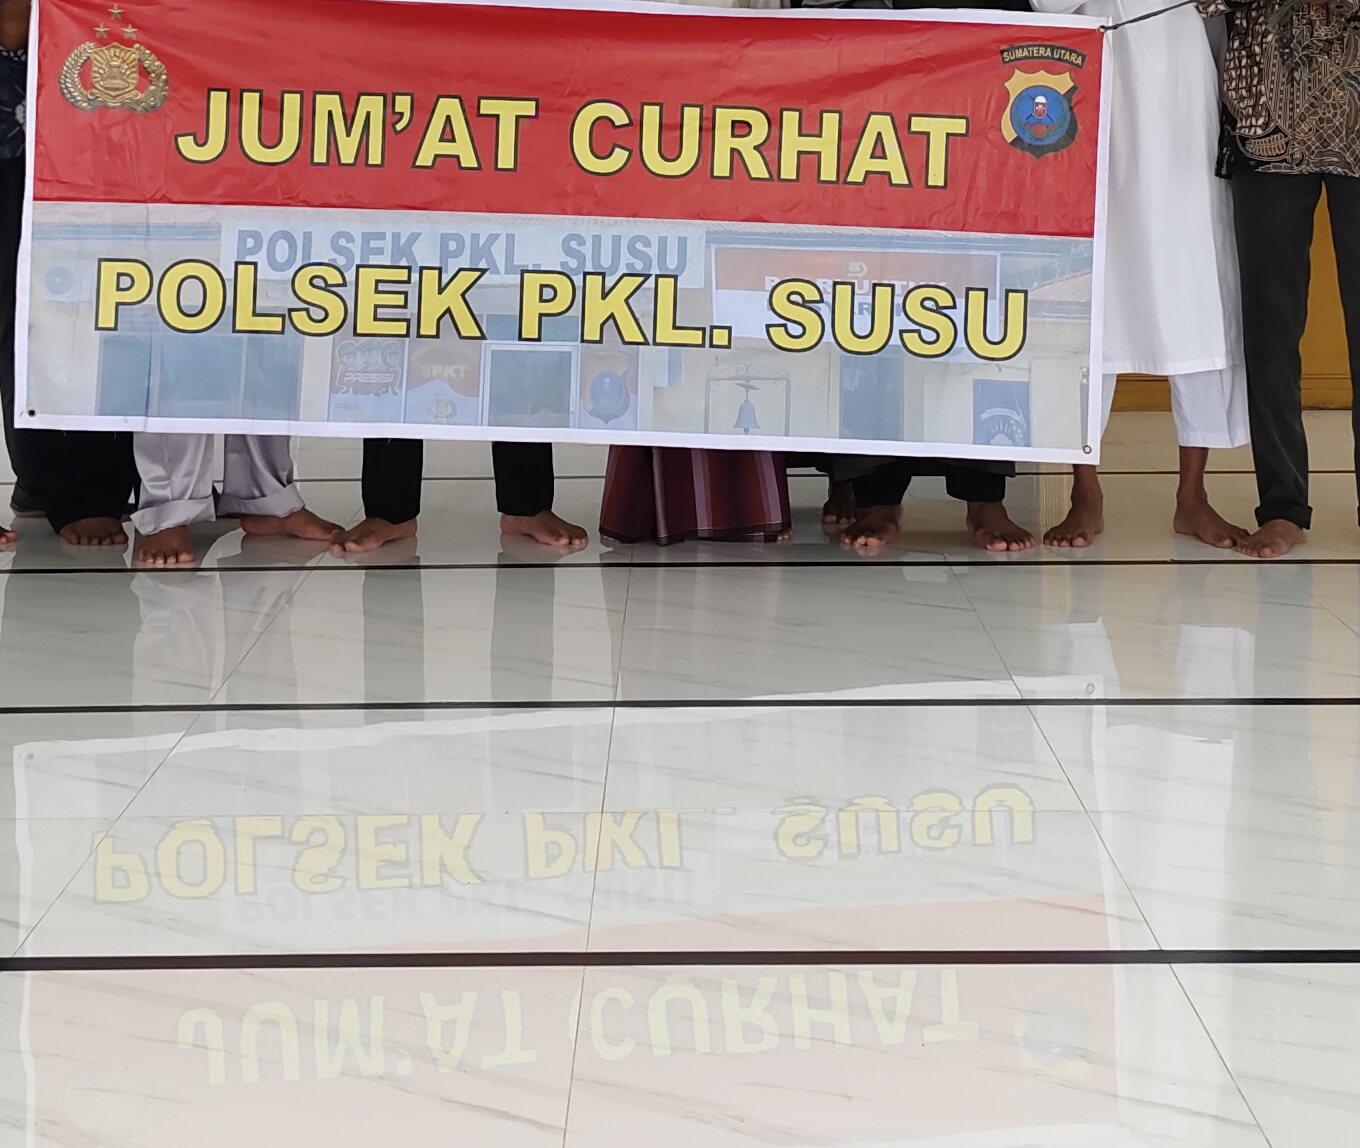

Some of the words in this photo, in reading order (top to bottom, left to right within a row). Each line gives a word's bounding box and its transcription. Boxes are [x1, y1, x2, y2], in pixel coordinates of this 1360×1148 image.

[1002, 46, 1052, 62] SUMATERA
[1053, 48, 1084, 66] UTARA
[175, 87, 538, 172] JUM'AT
[570, 98, 969, 190] CURHAT
[237, 228, 424, 275] POLSEK
[559, 233, 688, 278] SUSU
[94, 258, 487, 341] POLSEK
[518, 268, 733, 350] PKL.
[765, 278, 1029, 361] SUSU
[420, 364, 468, 378] SPKT
